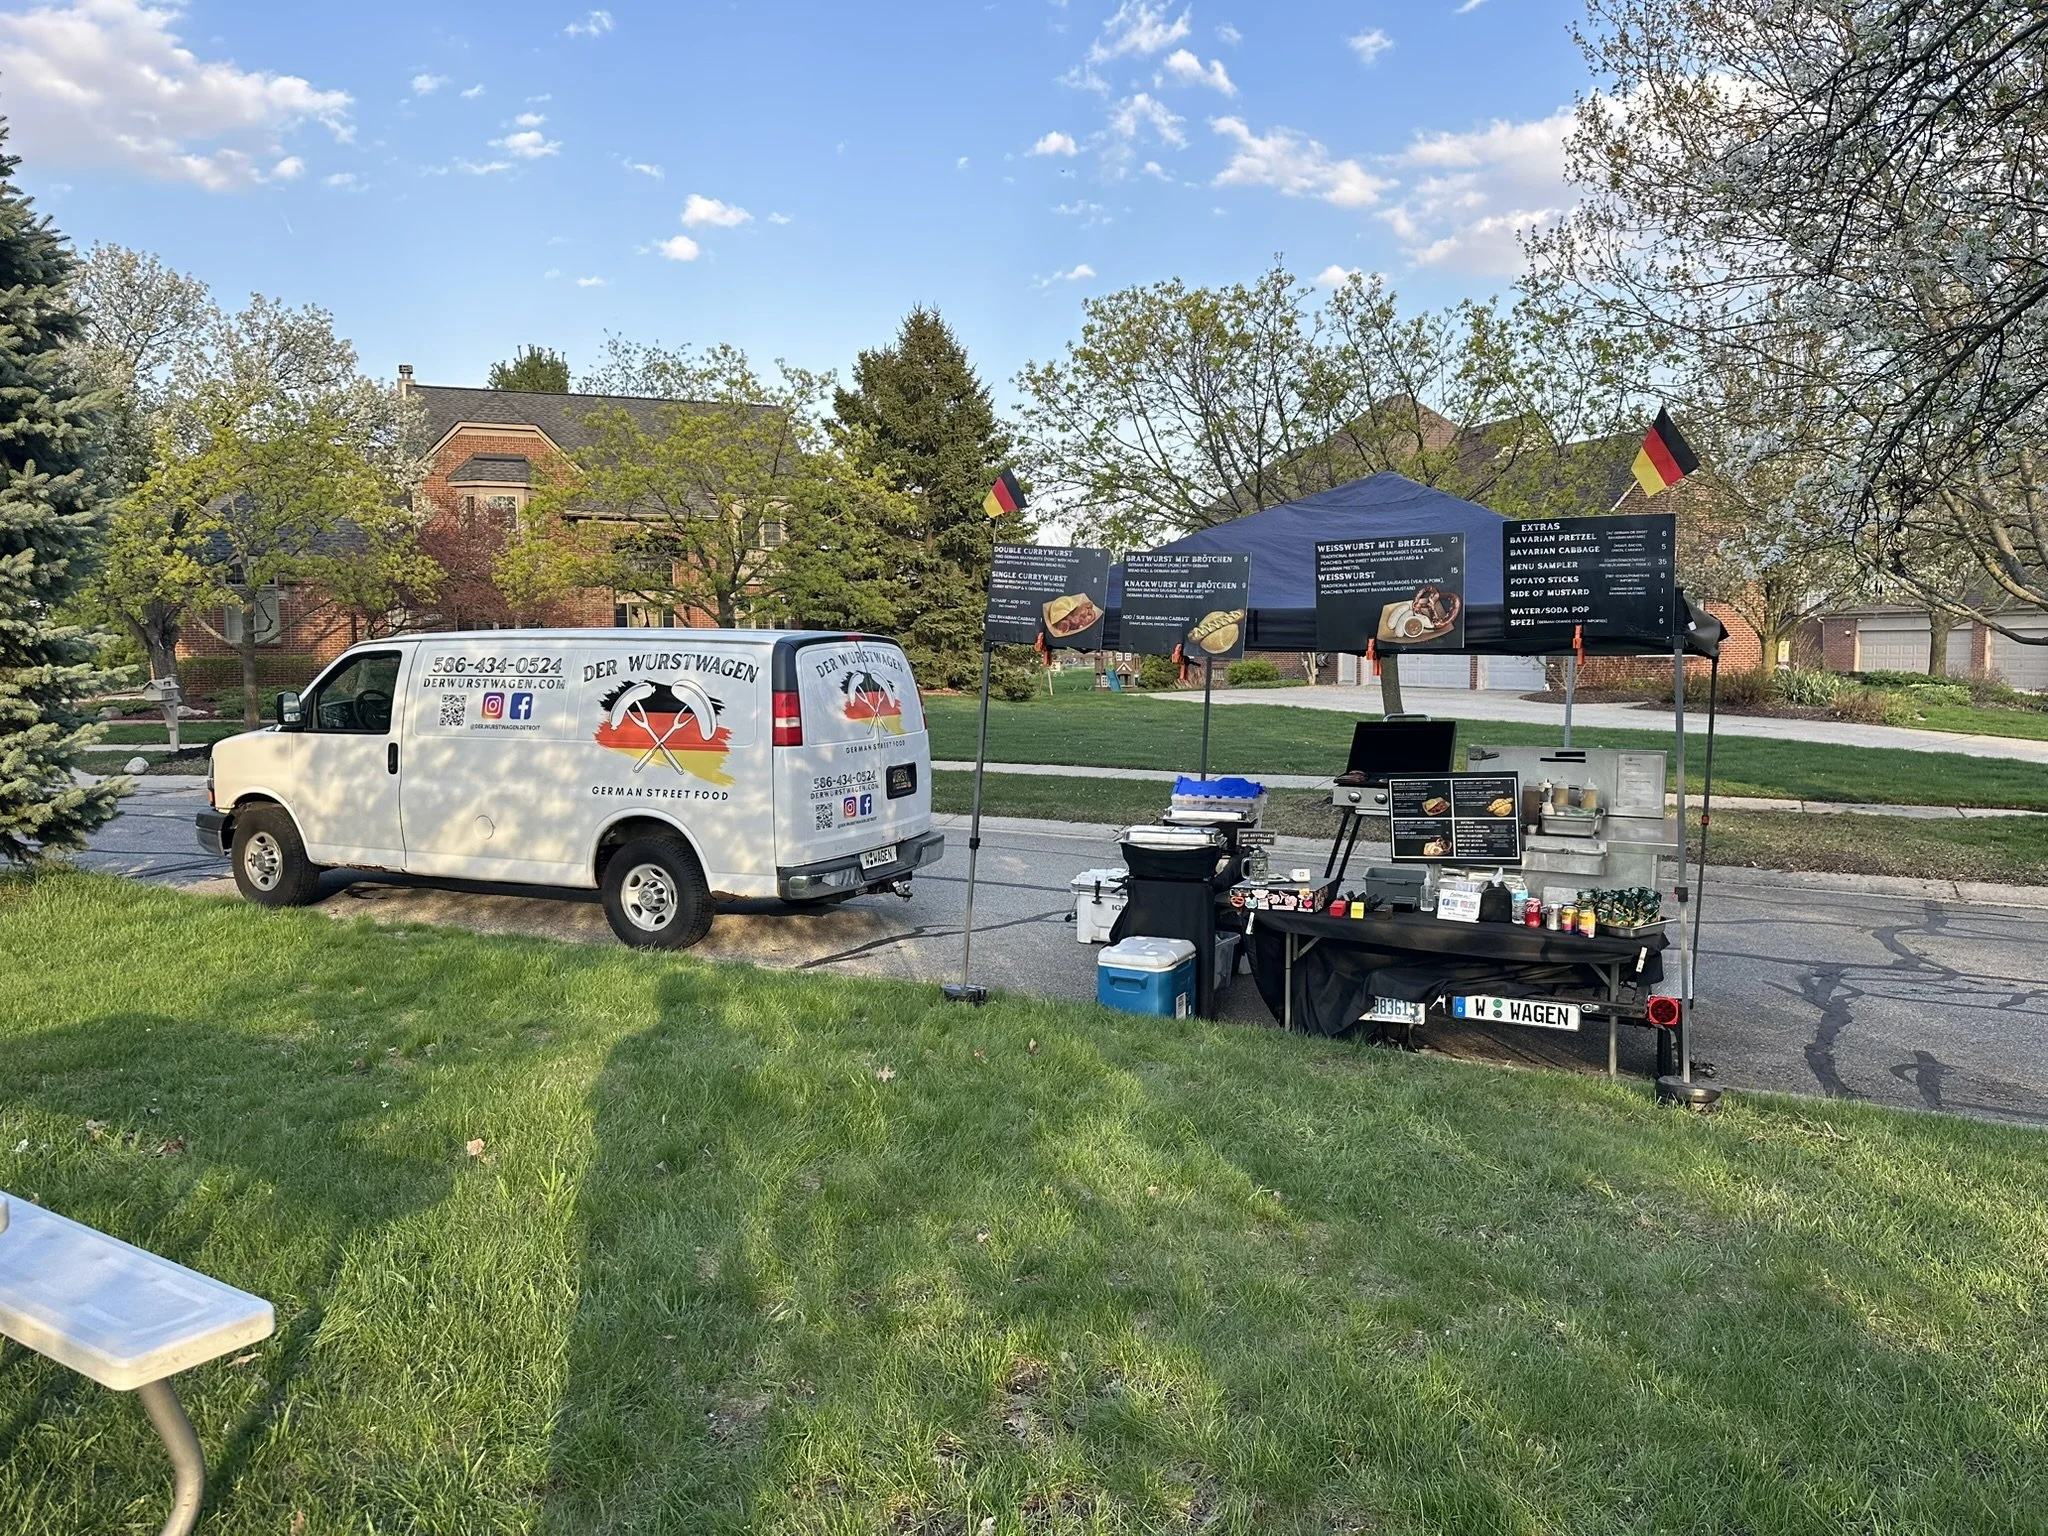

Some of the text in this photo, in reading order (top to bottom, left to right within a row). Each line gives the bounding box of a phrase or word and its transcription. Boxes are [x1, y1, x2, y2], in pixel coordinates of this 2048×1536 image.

[1521, 522, 1560, 532] EXTRAS
[1510, 533, 1597, 544] BAVARIAN PRETZEL
[1317, 539, 1431, 552] WEISSWURST MIT BREZEL
[994, 546, 1073, 557] DOUBLE CURRYWURST
[1510, 546, 1600, 556] BAVARIAN CABBAGE
[1192, 554, 1232, 563] BRÖTCHEN
[1510, 561, 1578, 571] MENU SAMPLER
[1018, 573, 1068, 582] CURRYWURST
[1318, 571, 1375, 581] WEISSWURST
[1548, 576, 1579, 584] STICKS
[1125, 580, 1178, 588] KNACKWURST
[1197, 580, 1237, 589] BRÖTCHEN
[1510, 590, 1530, 598] SIDE
[1548, 588, 1590, 596] MUSTARD
[1510, 607, 1569, 615] WATER/SODA
[1510, 618, 1535, 626] SPEZI
[432, 656, 563, 674] 586-434-0524
[583, 653, 759, 684] DER WURSTWAGEN
[816, 651, 903, 678] DER WURSTWAGEN
[423, 678, 566, 690] DERWURSTWAGEN.COM
[846, 745, 871, 754] GERMAN
[813, 770, 876, 790] 586-434-0524
[591, 786, 728, 801] GERMAN STREET FOOD
[810, 784, 879, 800] DERWURSTWAGEN.COM
[1475, 998, 1569, 1026] W WAGEN
